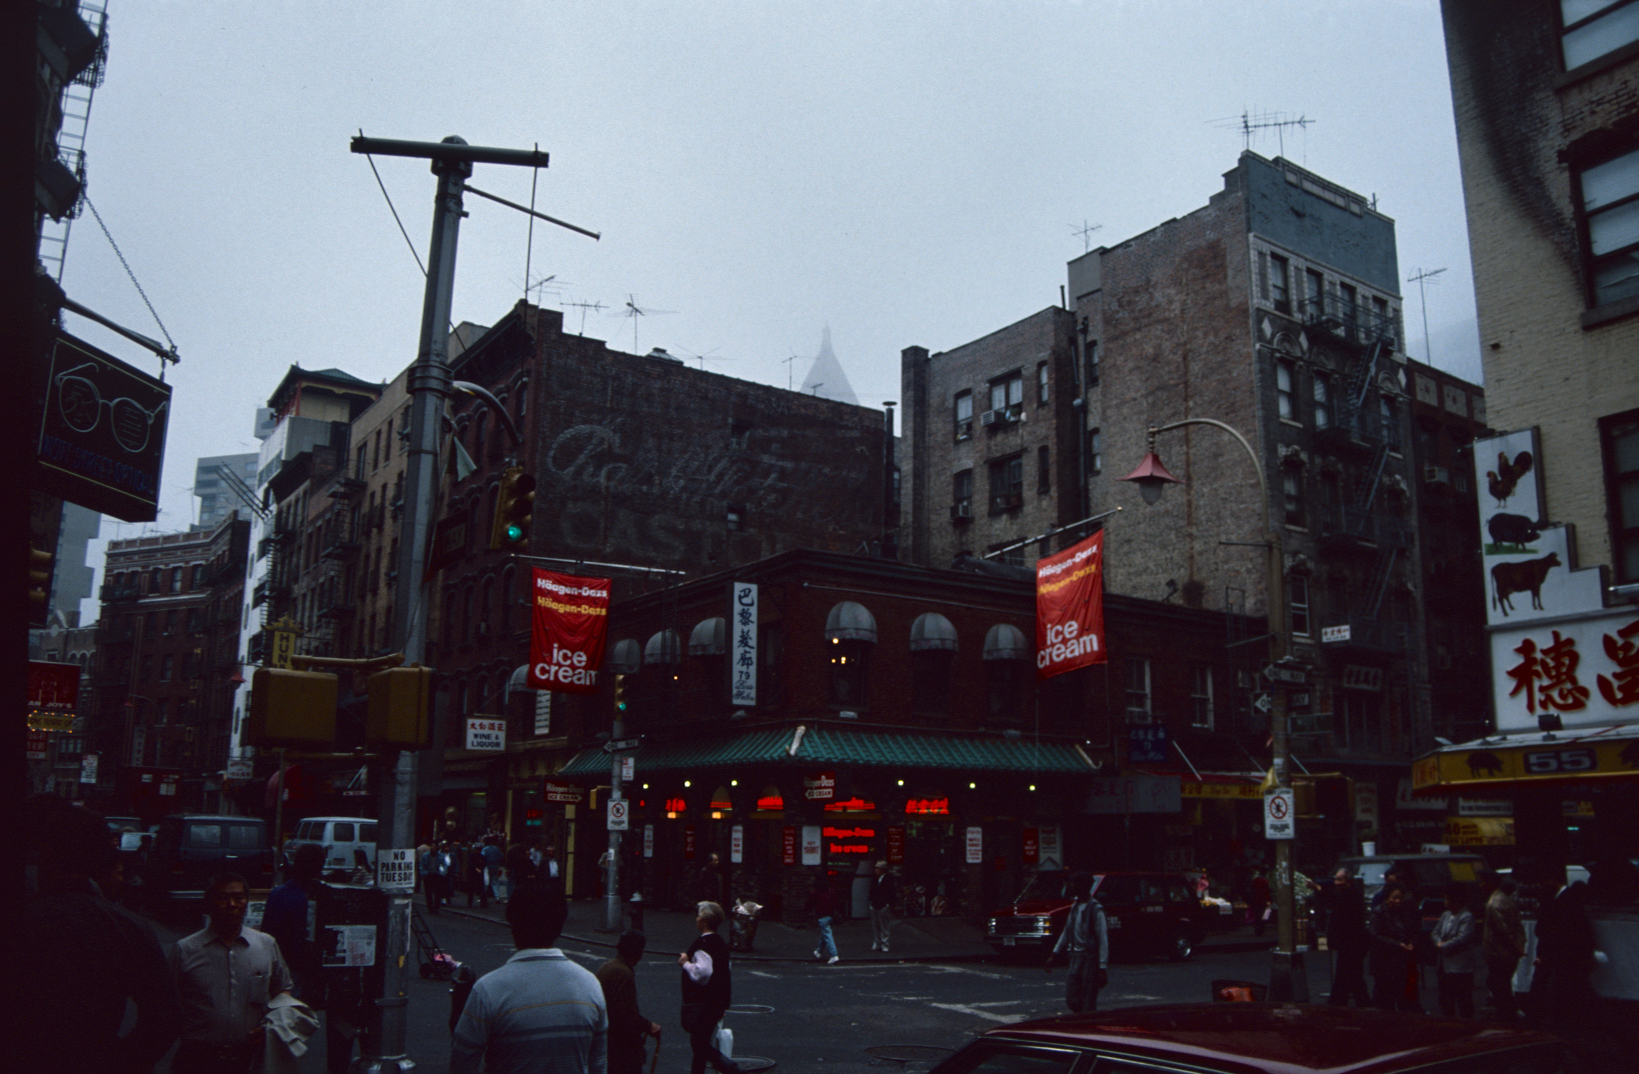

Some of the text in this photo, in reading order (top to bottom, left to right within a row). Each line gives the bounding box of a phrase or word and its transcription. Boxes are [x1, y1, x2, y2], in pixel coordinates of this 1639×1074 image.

[536, 578, 609, 599] Häagen-Dazs
[537, 596, 607, 616] Häagen-Dazs
[1047, 620, 1078, 645] ice
[552, 643, 588, 667] ice
[1037, 633, 1099, 669] cream
[738, 671, 750, 680] 79
[1529, 751, 1591, 773] 55
[393, 851, 405, 861] NO
